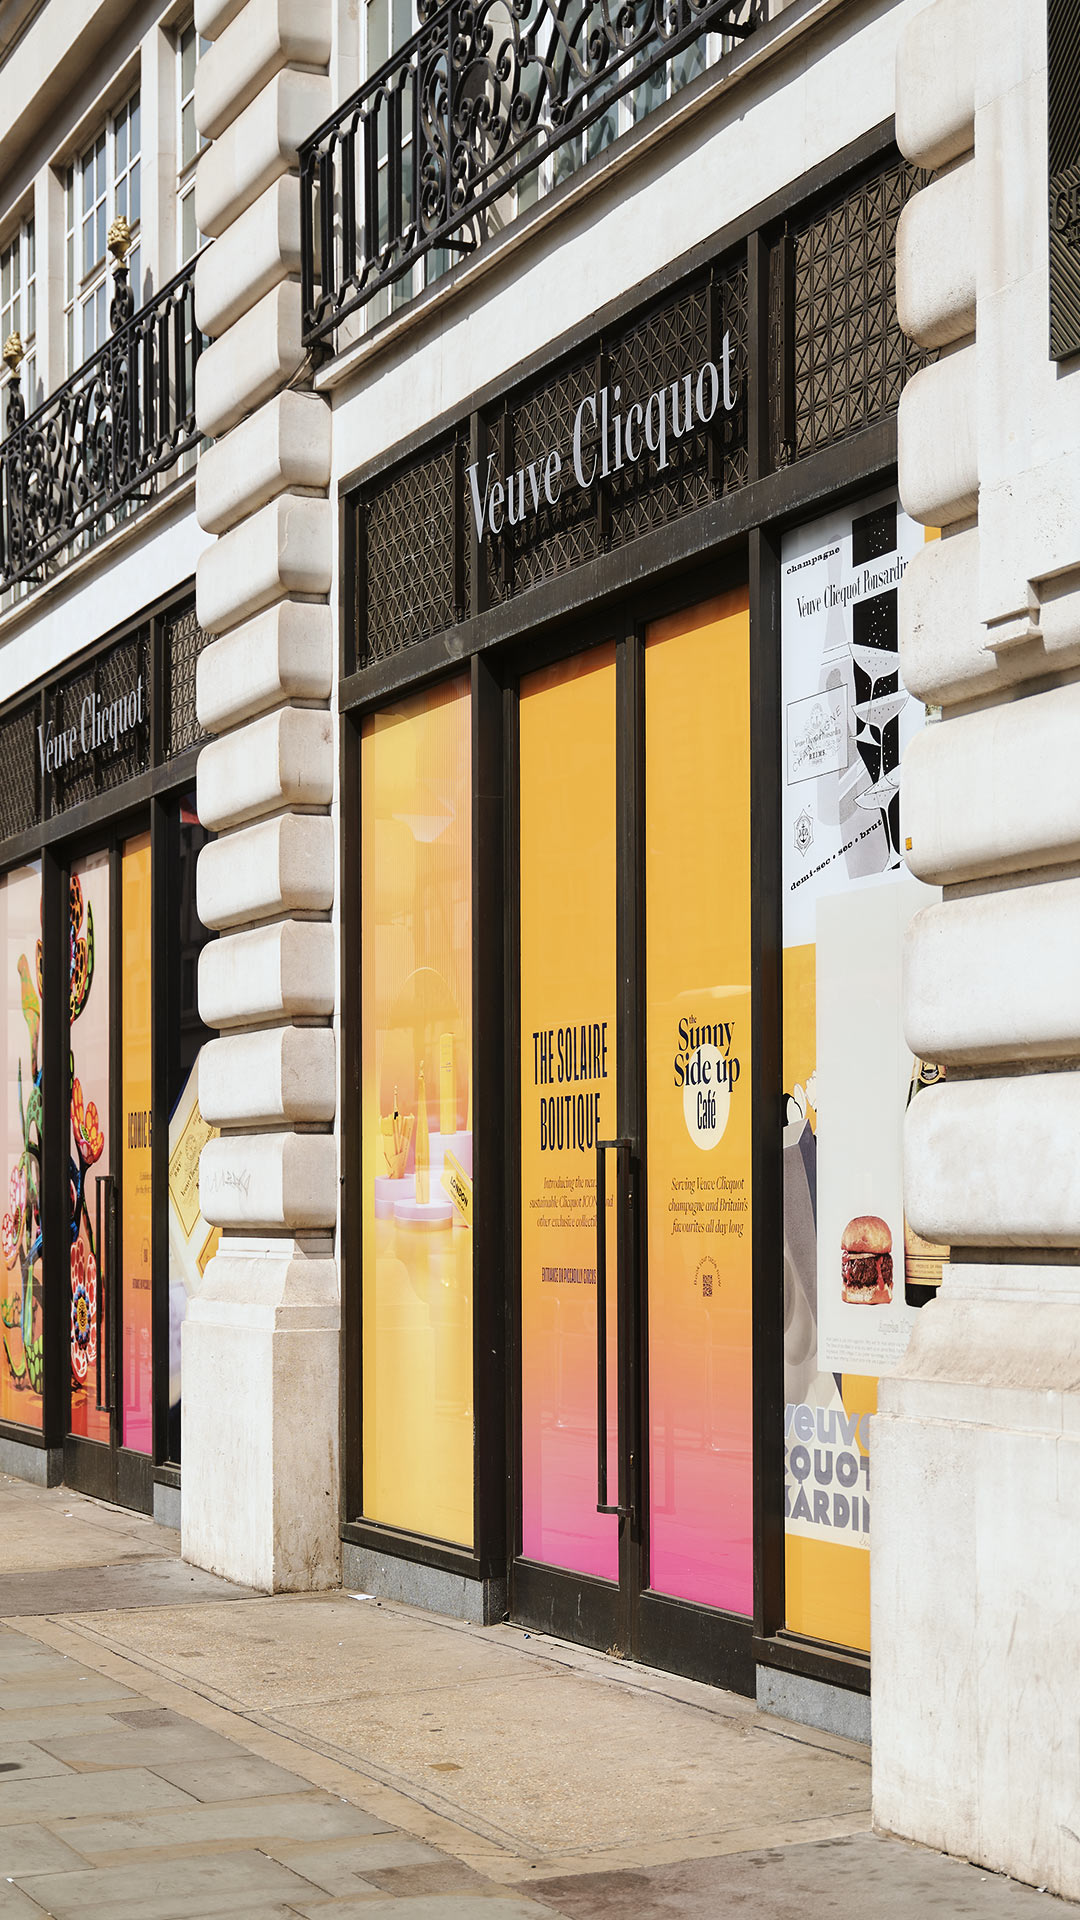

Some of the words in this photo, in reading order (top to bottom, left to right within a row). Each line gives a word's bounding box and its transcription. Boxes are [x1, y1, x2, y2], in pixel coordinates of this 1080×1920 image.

[465, 450, 562, 543] Veuve
[573, 329, 738, 488] Clicquot
[786, 547, 840, 575] champagne
[796, 595, 822, 619] Veuve
[823, 575, 861, 609] Clicquot
[37, 720, 77, 777] Veuve
[81, 674, 144, 754] Clicquot
[859, 818, 883, 840] brut
[689, 1014, 697, 1024] the
[678, 1017, 735, 1056] Sunny
[533, 1030, 554, 1085] THE
[557, 1022, 607, 1083] SOLAIRE
[674, 1049, 712, 1087] Side
[716, 1057, 740, 1092] up
[541, 1092, 600, 1152] BOUTIQUE
[697, 1089, 716, 1130] Café
[544, 1176, 574, 1192] Introducing
[575, 1176, 584, 1188] the
[671, 1177, 695, 1195] Serving
[697, 1177, 715, 1190] Veuve
[716, 1175, 744, 1194] Clicquot
[559, 1195, 582, 1211] Clicquot
[668, 1198, 704, 1216] champagne
[705, 1198, 719, 1211] and
[720, 1198, 748, 1212] Britain's
[537, 1214, 551, 1227] other
[670, 1218, 705, 1236] favourites
[706, 1219, 714, 1233] all
[715, 1219, 728, 1236] day
[729, 1219, 744, 1238] long
[785, 1445, 870, 1491] QUOT
